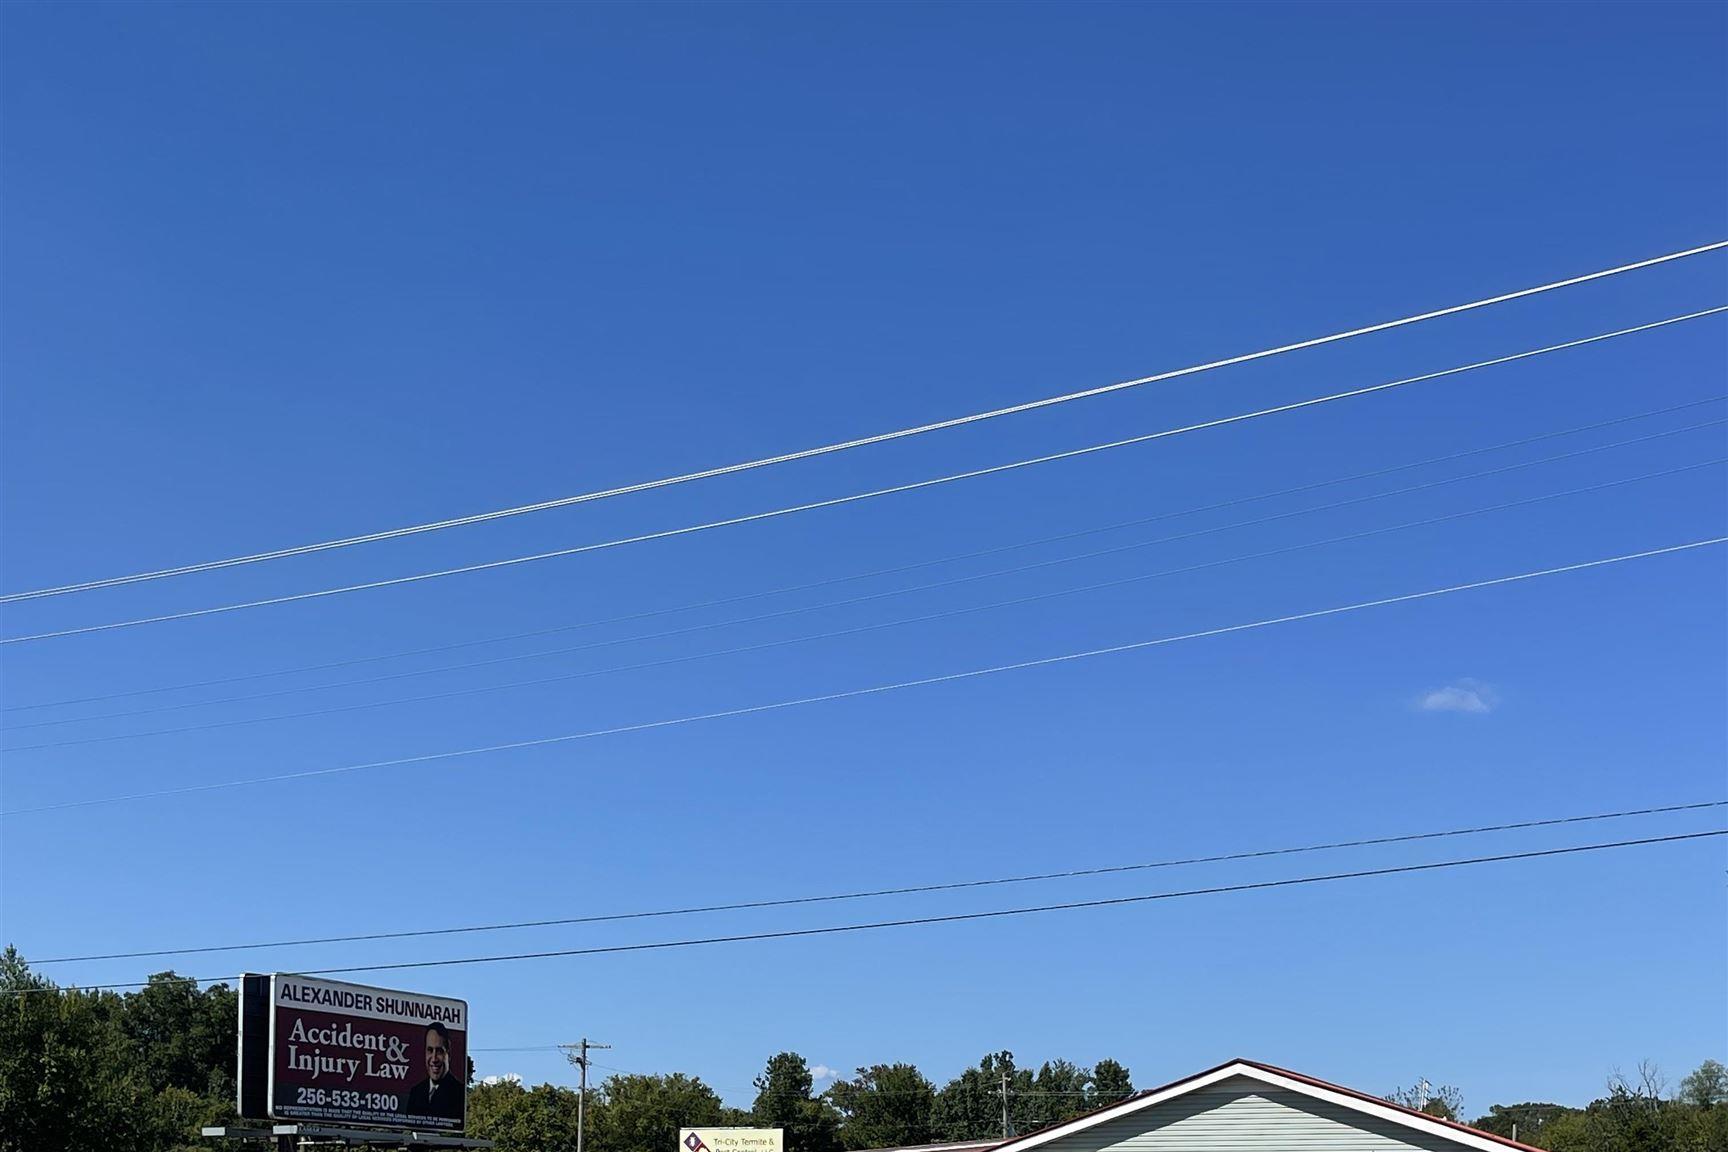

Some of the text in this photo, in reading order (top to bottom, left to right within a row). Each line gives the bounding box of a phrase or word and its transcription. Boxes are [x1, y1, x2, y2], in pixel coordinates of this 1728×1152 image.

[280, 983, 461, 1024] ALEXANDER SHUNNARAH
[288, 1018, 387, 1051] Accident
[288, 1044, 410, 1081] Injury Law
[297, 1087, 399, 1112] 256-533-1300
[713, 1138, 775, 1147] Tri-City Termite &
